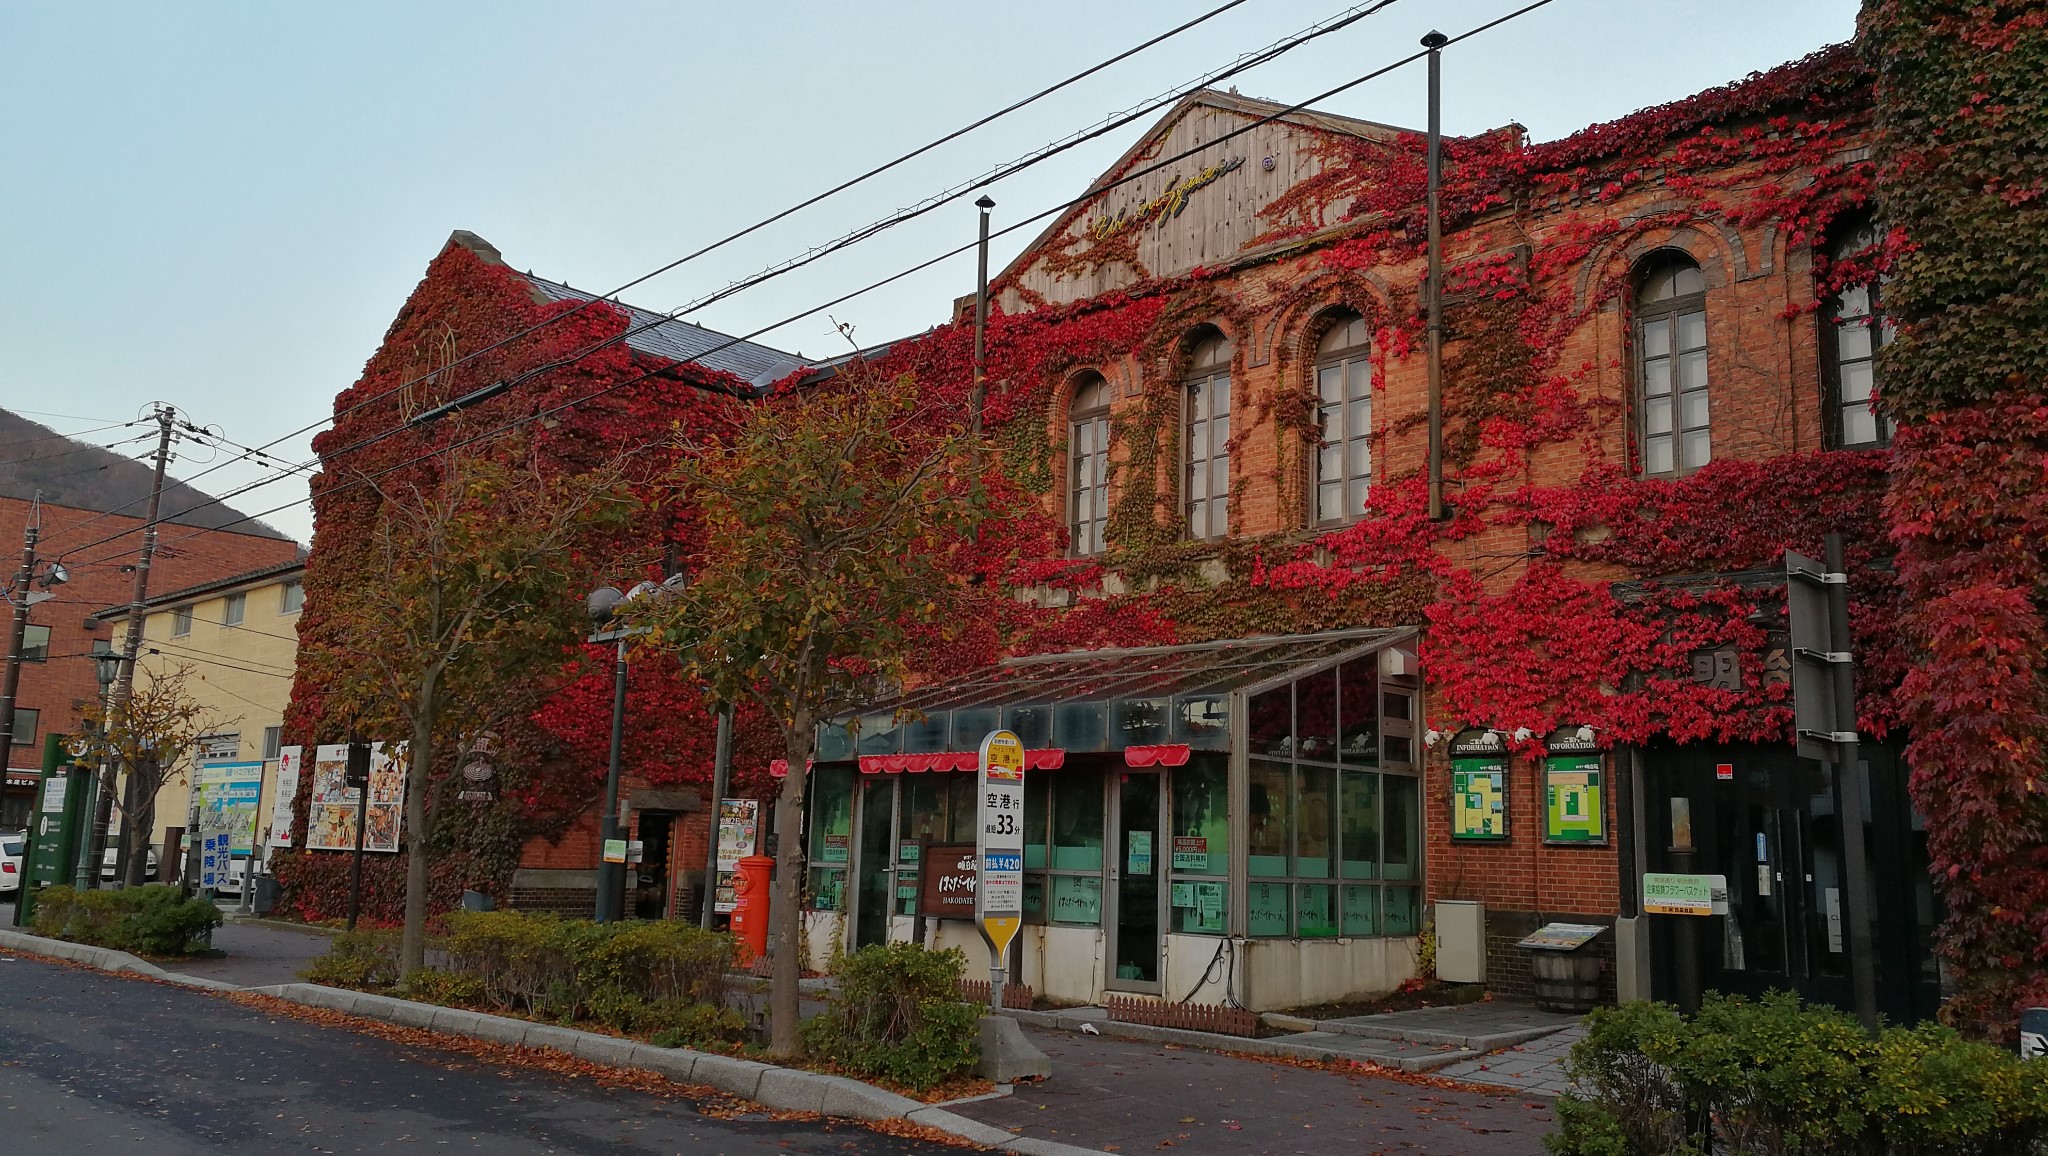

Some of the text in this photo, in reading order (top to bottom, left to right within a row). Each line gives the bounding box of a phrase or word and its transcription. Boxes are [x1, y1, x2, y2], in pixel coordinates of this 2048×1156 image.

[1549, 742, 1596, 750] INFORMATION
[987, 792, 1020, 810] 空港行
[203, 838, 217, 886] 乗降場
[216, 833, 230, 885] 観光バス
[938, 874, 977, 893] はこだてわ
[942, 896, 974, 905] HAKODATE
